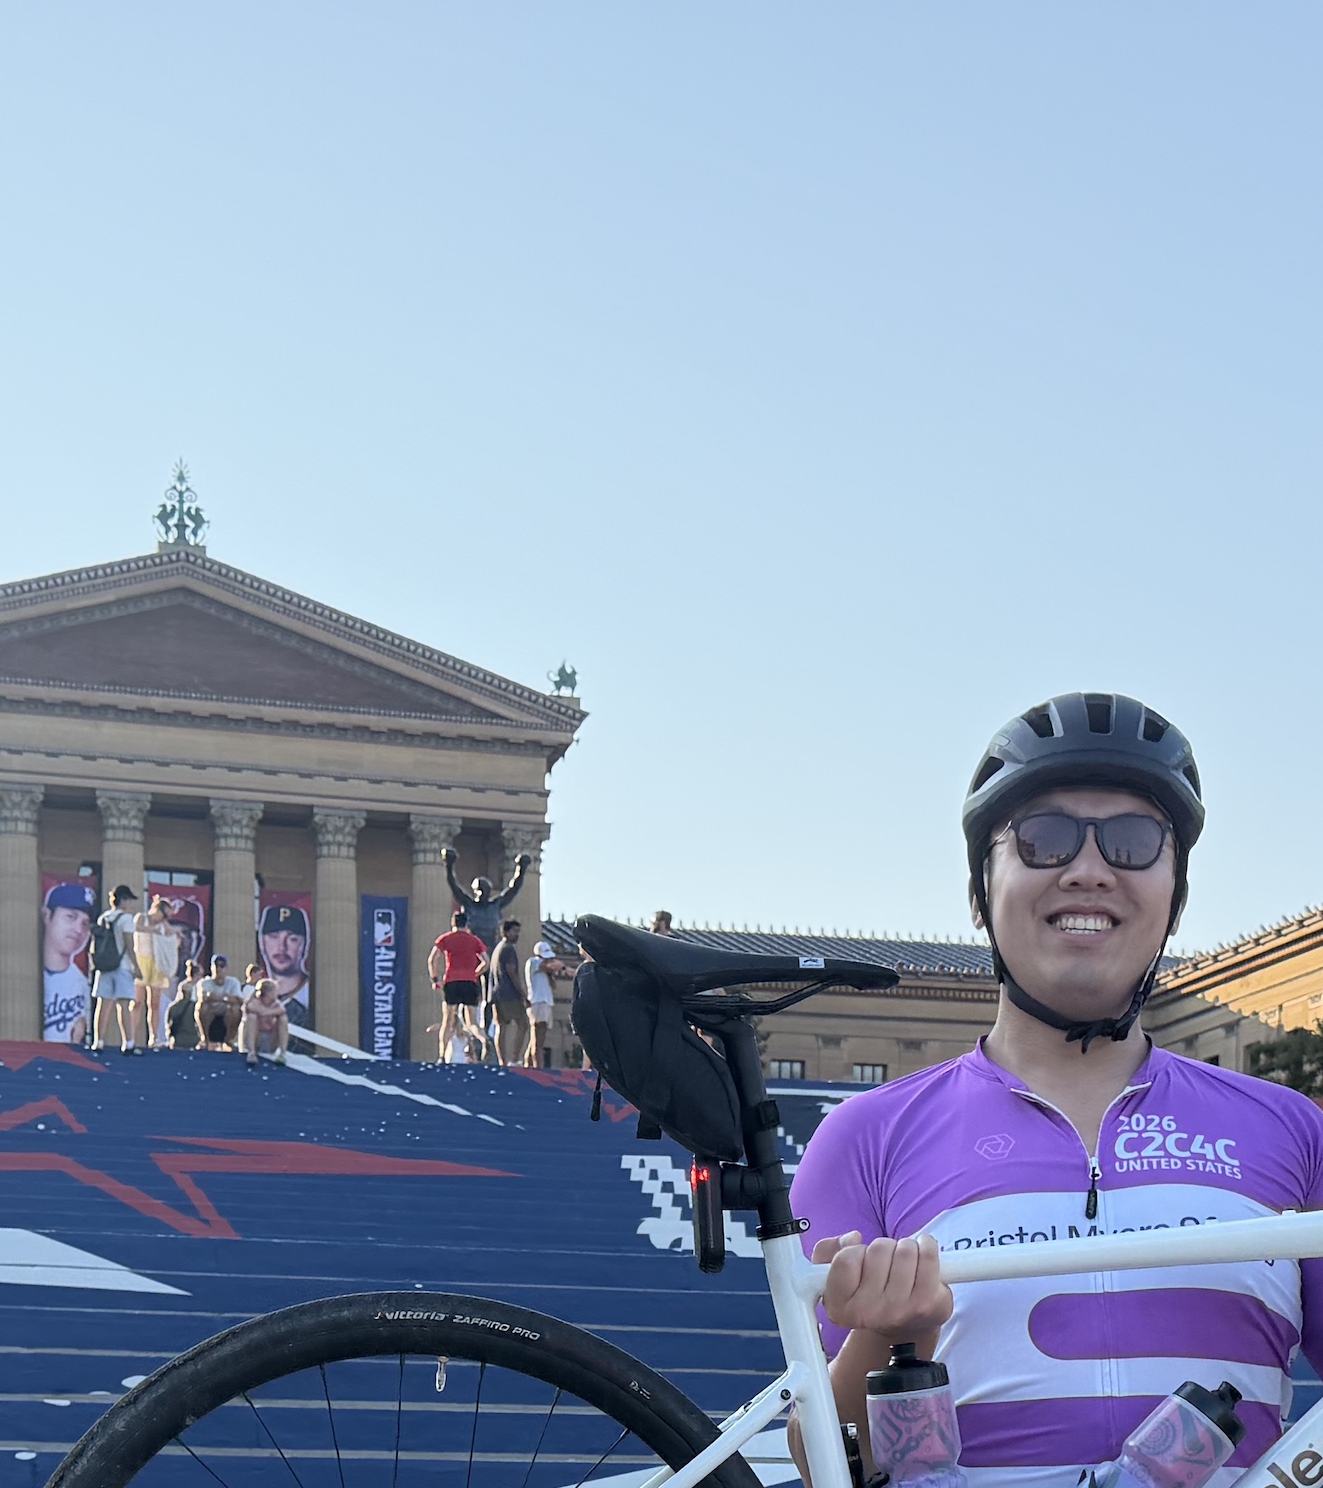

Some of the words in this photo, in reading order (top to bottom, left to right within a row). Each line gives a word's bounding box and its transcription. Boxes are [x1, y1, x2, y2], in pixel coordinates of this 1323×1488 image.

[279, 907, 291, 923] P
[374, 981, 396, 1024] STAR
[1116, 1113, 1177, 1133] 2026
[1114, 1131, 1240, 1166] C2C4C
[1115, 1157, 1182, 1173] UNITED
[1186, 1158, 1243, 1180] STATES
[385, 1310, 446, 1322] vittoria
[452, 1314, 511, 1332] ZAFFIRO
[512, 1326, 542, 1341] PRO
